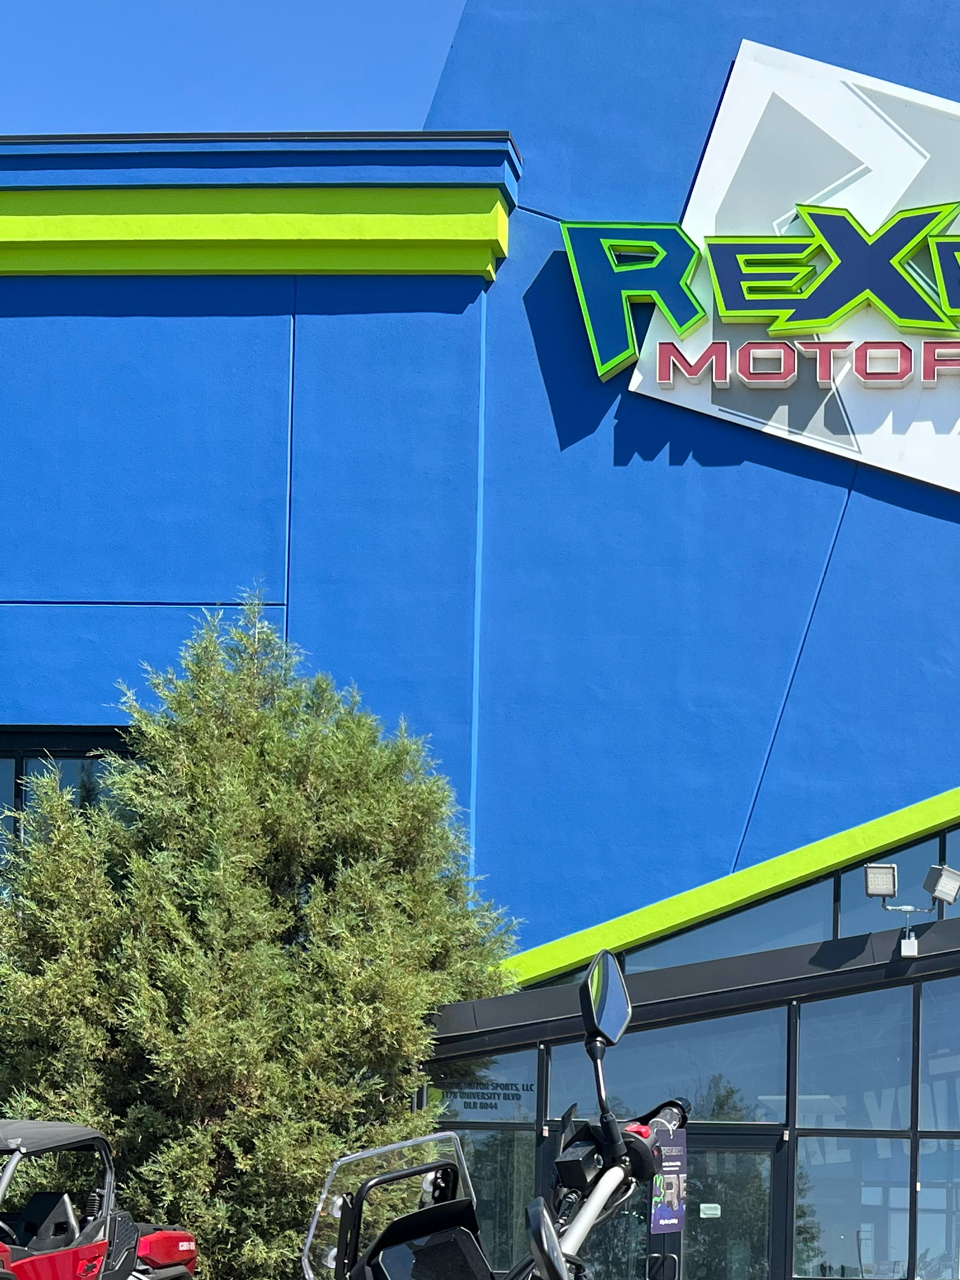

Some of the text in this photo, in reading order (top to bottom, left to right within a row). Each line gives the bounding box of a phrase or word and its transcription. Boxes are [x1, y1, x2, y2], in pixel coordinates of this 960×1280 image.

[464, 1082, 489, 1091] MOTOR
[491, 1083, 519, 1092] SPORTS,
[522, 1083, 535, 1092] LLC
[459, 1092, 501, 1100] UNIVERSITY
[503, 1093, 521, 1101] BLVD
[463, 1101, 498, 1110] DLR 8044
